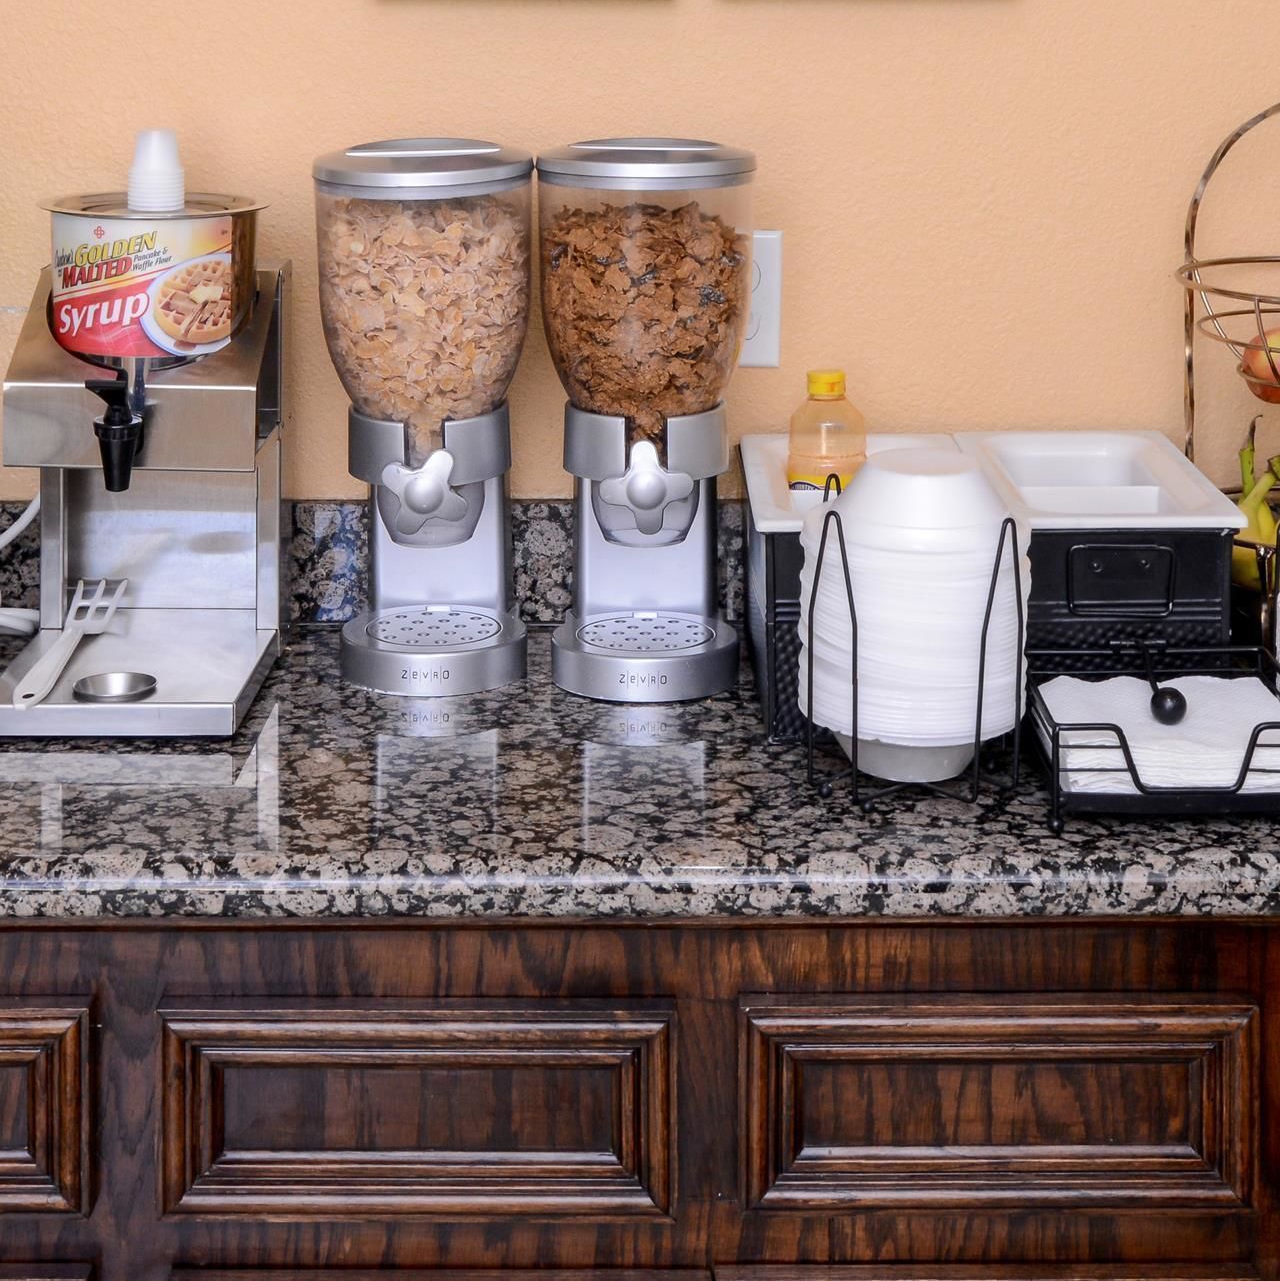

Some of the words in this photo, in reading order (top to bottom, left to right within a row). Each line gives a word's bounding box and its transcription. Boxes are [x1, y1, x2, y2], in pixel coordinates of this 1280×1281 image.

[74, 230, 157, 267] GOLDEN
[62, 256, 133, 290] MALTED
[59, 292, 149, 337] Syrup
